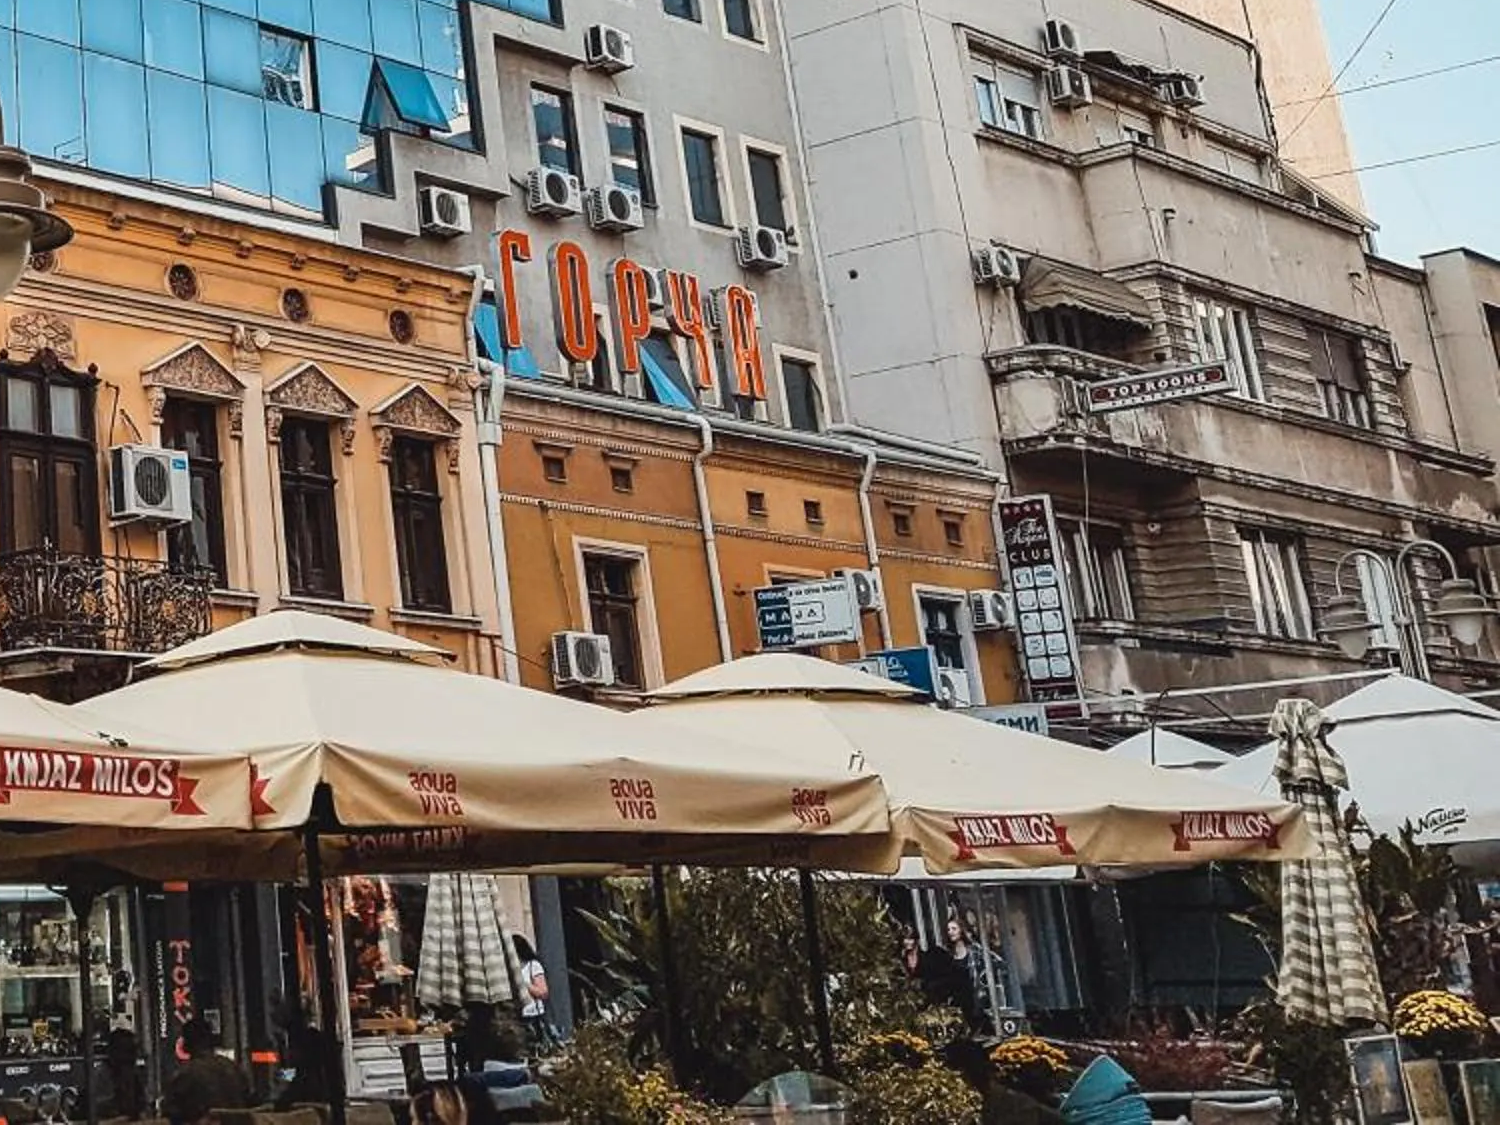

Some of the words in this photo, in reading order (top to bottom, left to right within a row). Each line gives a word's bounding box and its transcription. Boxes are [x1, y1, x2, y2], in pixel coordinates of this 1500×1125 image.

[499, 228, 767, 401] ГОРЧА
[1107, 384, 1141, 399] TOP
[1146, 373, 1207, 393] ROOMS
[1009, 547, 1051, 563] CLUB
[764, 607, 819, 623] MAJA
[3, 749, 82, 790] KNJAZ
[610, 778, 654, 799] aqua
[419, 794, 464, 816] viva
[615, 800, 657, 820] viva
